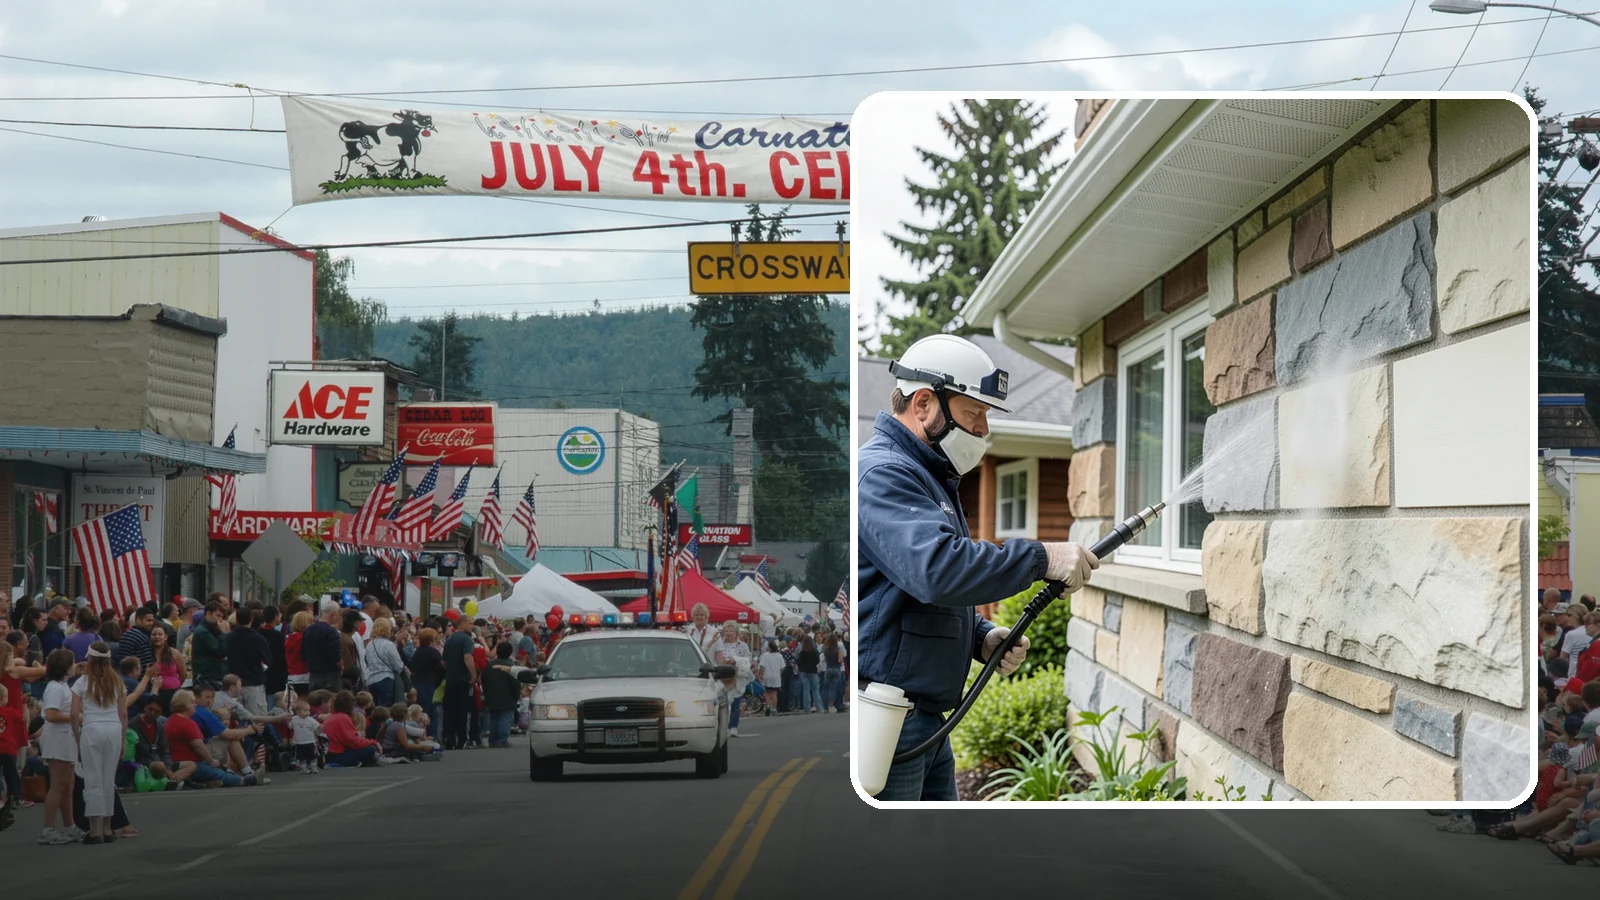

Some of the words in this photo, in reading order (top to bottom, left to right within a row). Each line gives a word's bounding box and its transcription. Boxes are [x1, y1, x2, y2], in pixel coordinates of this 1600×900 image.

[481, 141, 605, 193] JULY
[632, 150, 746, 198] 4th.
[696, 254, 850, 280] CROSSWA
[282, 380, 374, 420] ACE
[405, 409, 452, 422] CEDAR
[461, 409, 485, 422] LOG
[283, 421, 371, 437] Hardware
[353, 467, 386, 480] Simpl
[83, 485, 94, 494] St.
[96, 486, 124, 494] Vincent
[126, 486, 136, 495] de
[137, 486, 155, 495] Paul
[81, 503, 154, 522] THT
[212, 516, 331, 535] HARDARE
[688, 526, 741, 535] CRNATION
[699, 535, 730, 543] GLASS
